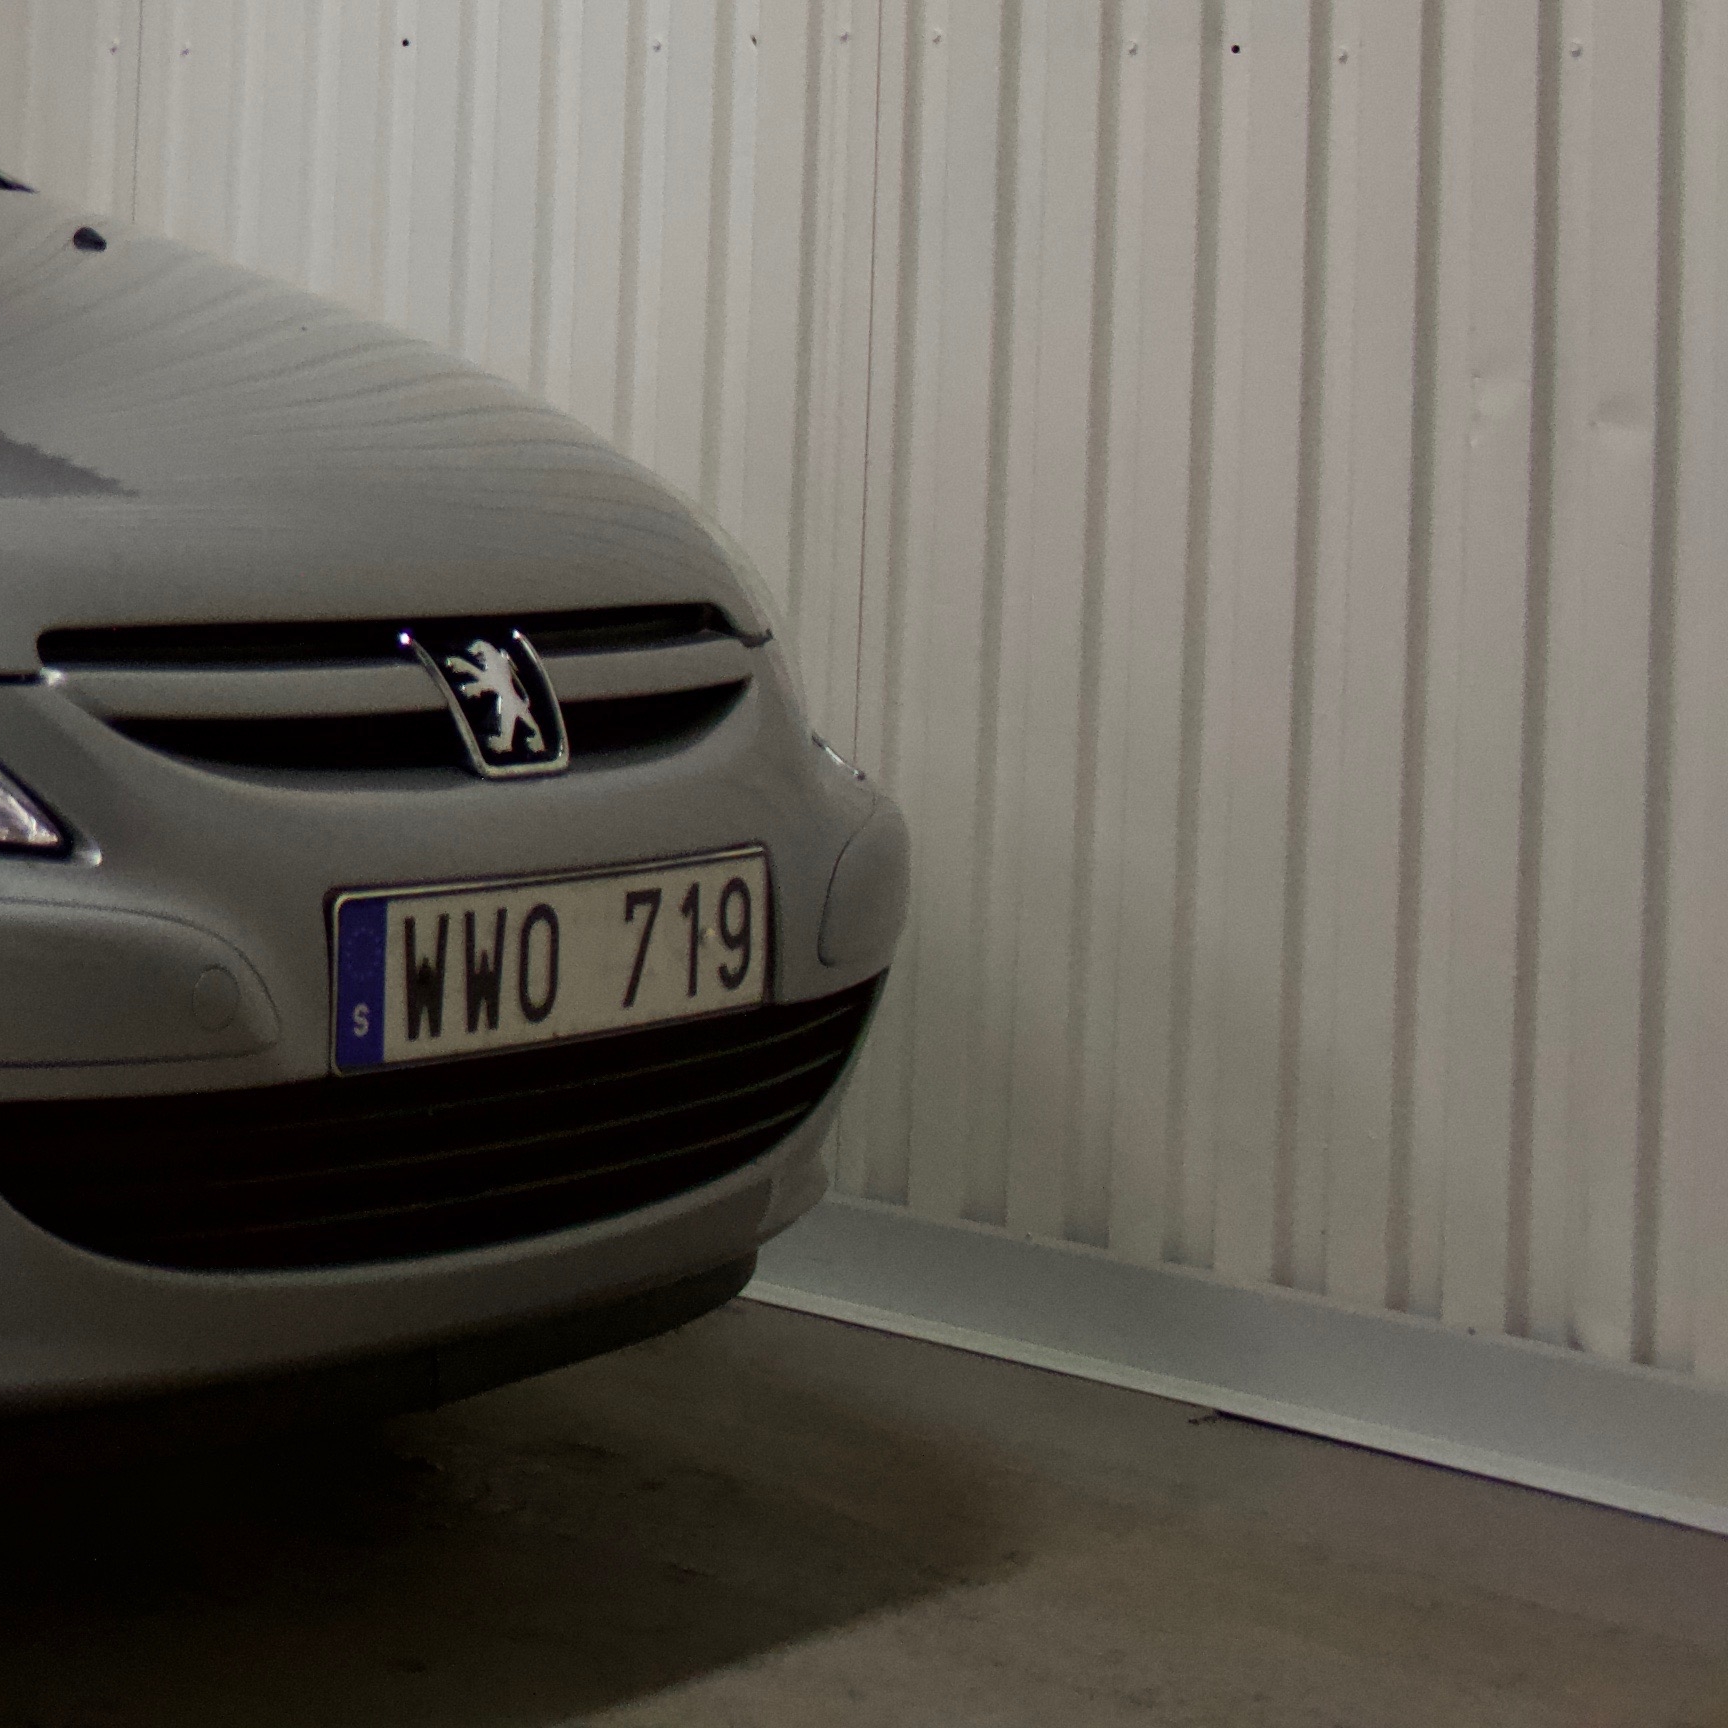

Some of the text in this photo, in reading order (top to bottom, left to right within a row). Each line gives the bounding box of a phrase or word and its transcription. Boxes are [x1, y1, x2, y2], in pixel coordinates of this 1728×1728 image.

[404, 877, 751, 1041] WWO 719
[353, 1003, 370, 1038] S
